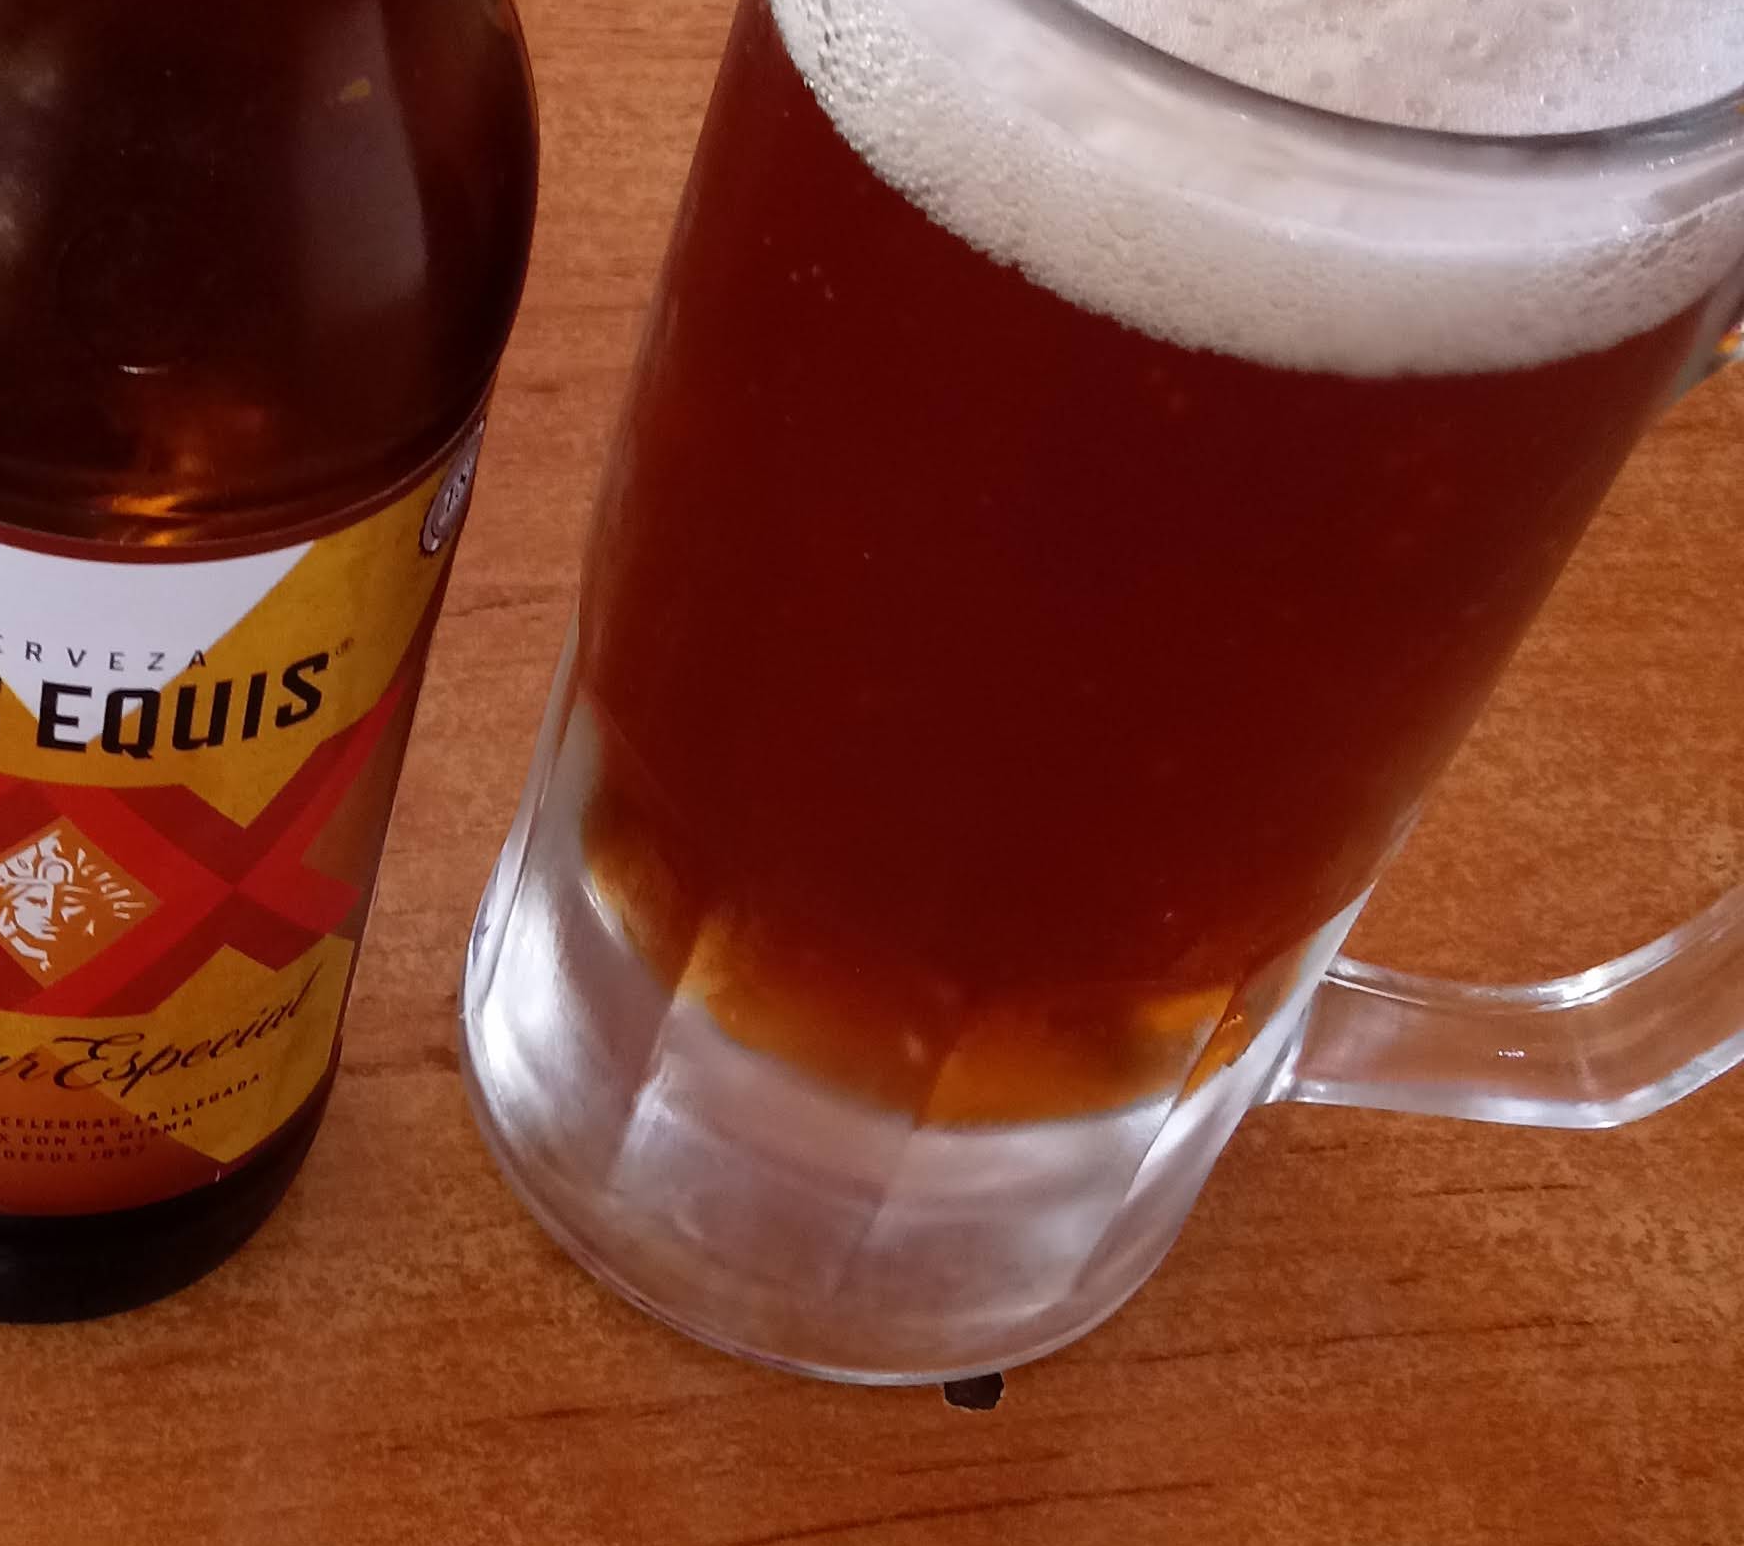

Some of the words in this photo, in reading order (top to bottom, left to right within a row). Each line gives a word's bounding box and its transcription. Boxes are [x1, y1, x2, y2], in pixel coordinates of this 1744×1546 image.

[35, 651, 330, 759] EQUIS
[52, 965, 326, 1099] Especial
[21, 1134, 67, 1147] CON
[80, 1133, 106, 1146] LA
[118, 1116, 194, 1142] MISMA
[134, 1110, 159, 1126] LA
[170, 1072, 261, 1116] LLEGADA
